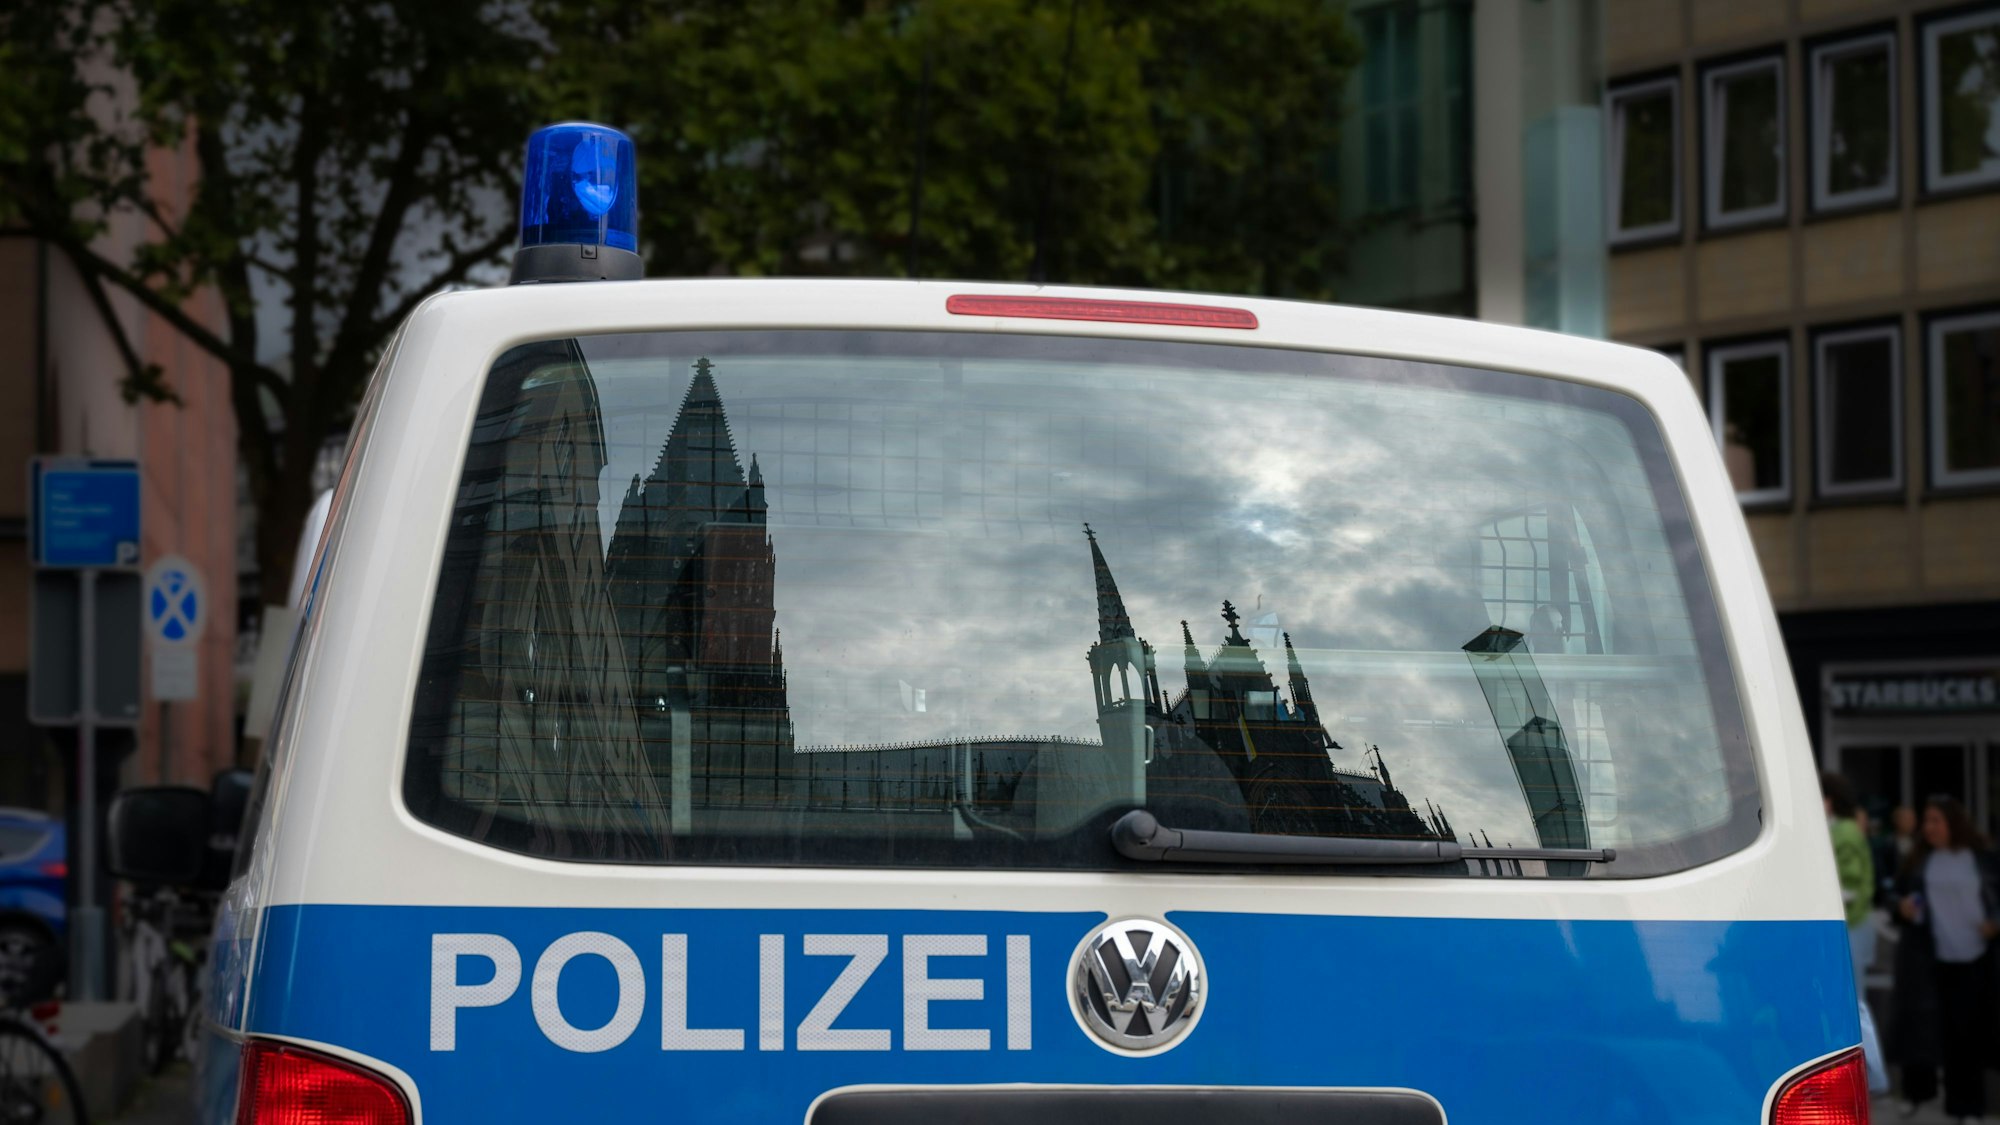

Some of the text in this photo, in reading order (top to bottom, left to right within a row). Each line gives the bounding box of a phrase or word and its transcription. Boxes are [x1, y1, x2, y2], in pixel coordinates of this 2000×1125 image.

[1831, 678, 1995, 707] STARBUCKS
[430, 930, 1032, 1053] POLIZEI
[1075, 919, 1200, 1051] VW
